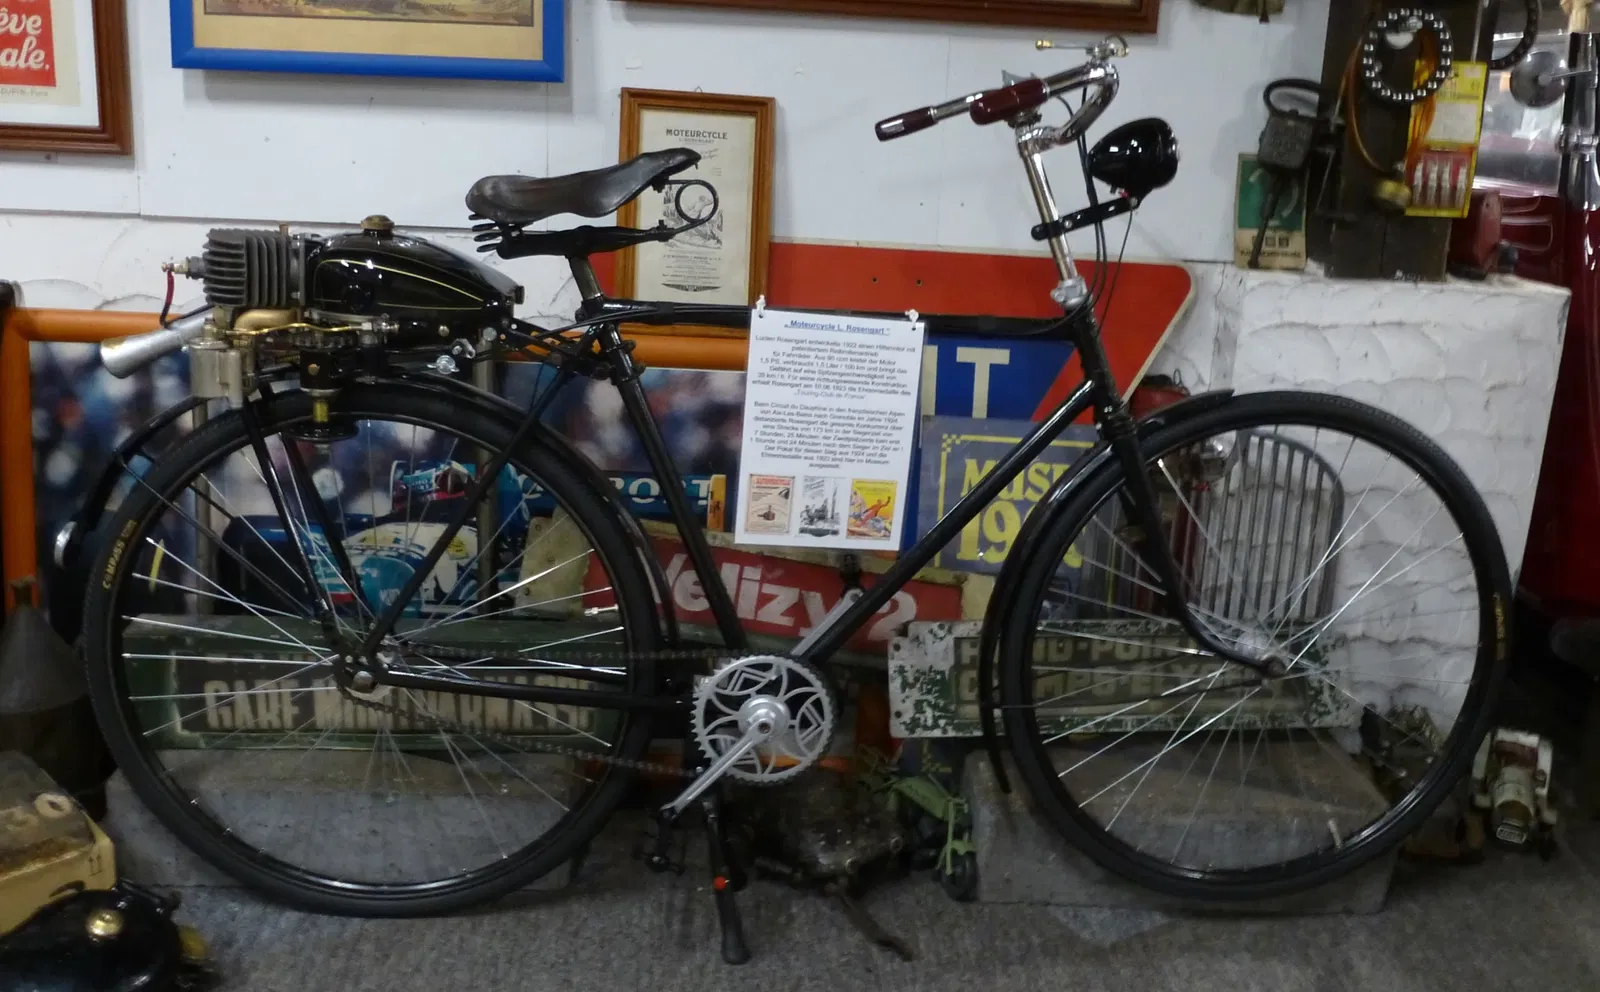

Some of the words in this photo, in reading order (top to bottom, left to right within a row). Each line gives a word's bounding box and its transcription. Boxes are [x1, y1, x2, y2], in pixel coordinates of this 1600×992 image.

[666, 129, 728, 140] MOTEURCYCLE
[790, 320, 836, 330] Moteurcycle
[846, 325, 884, 333] Rosengart
